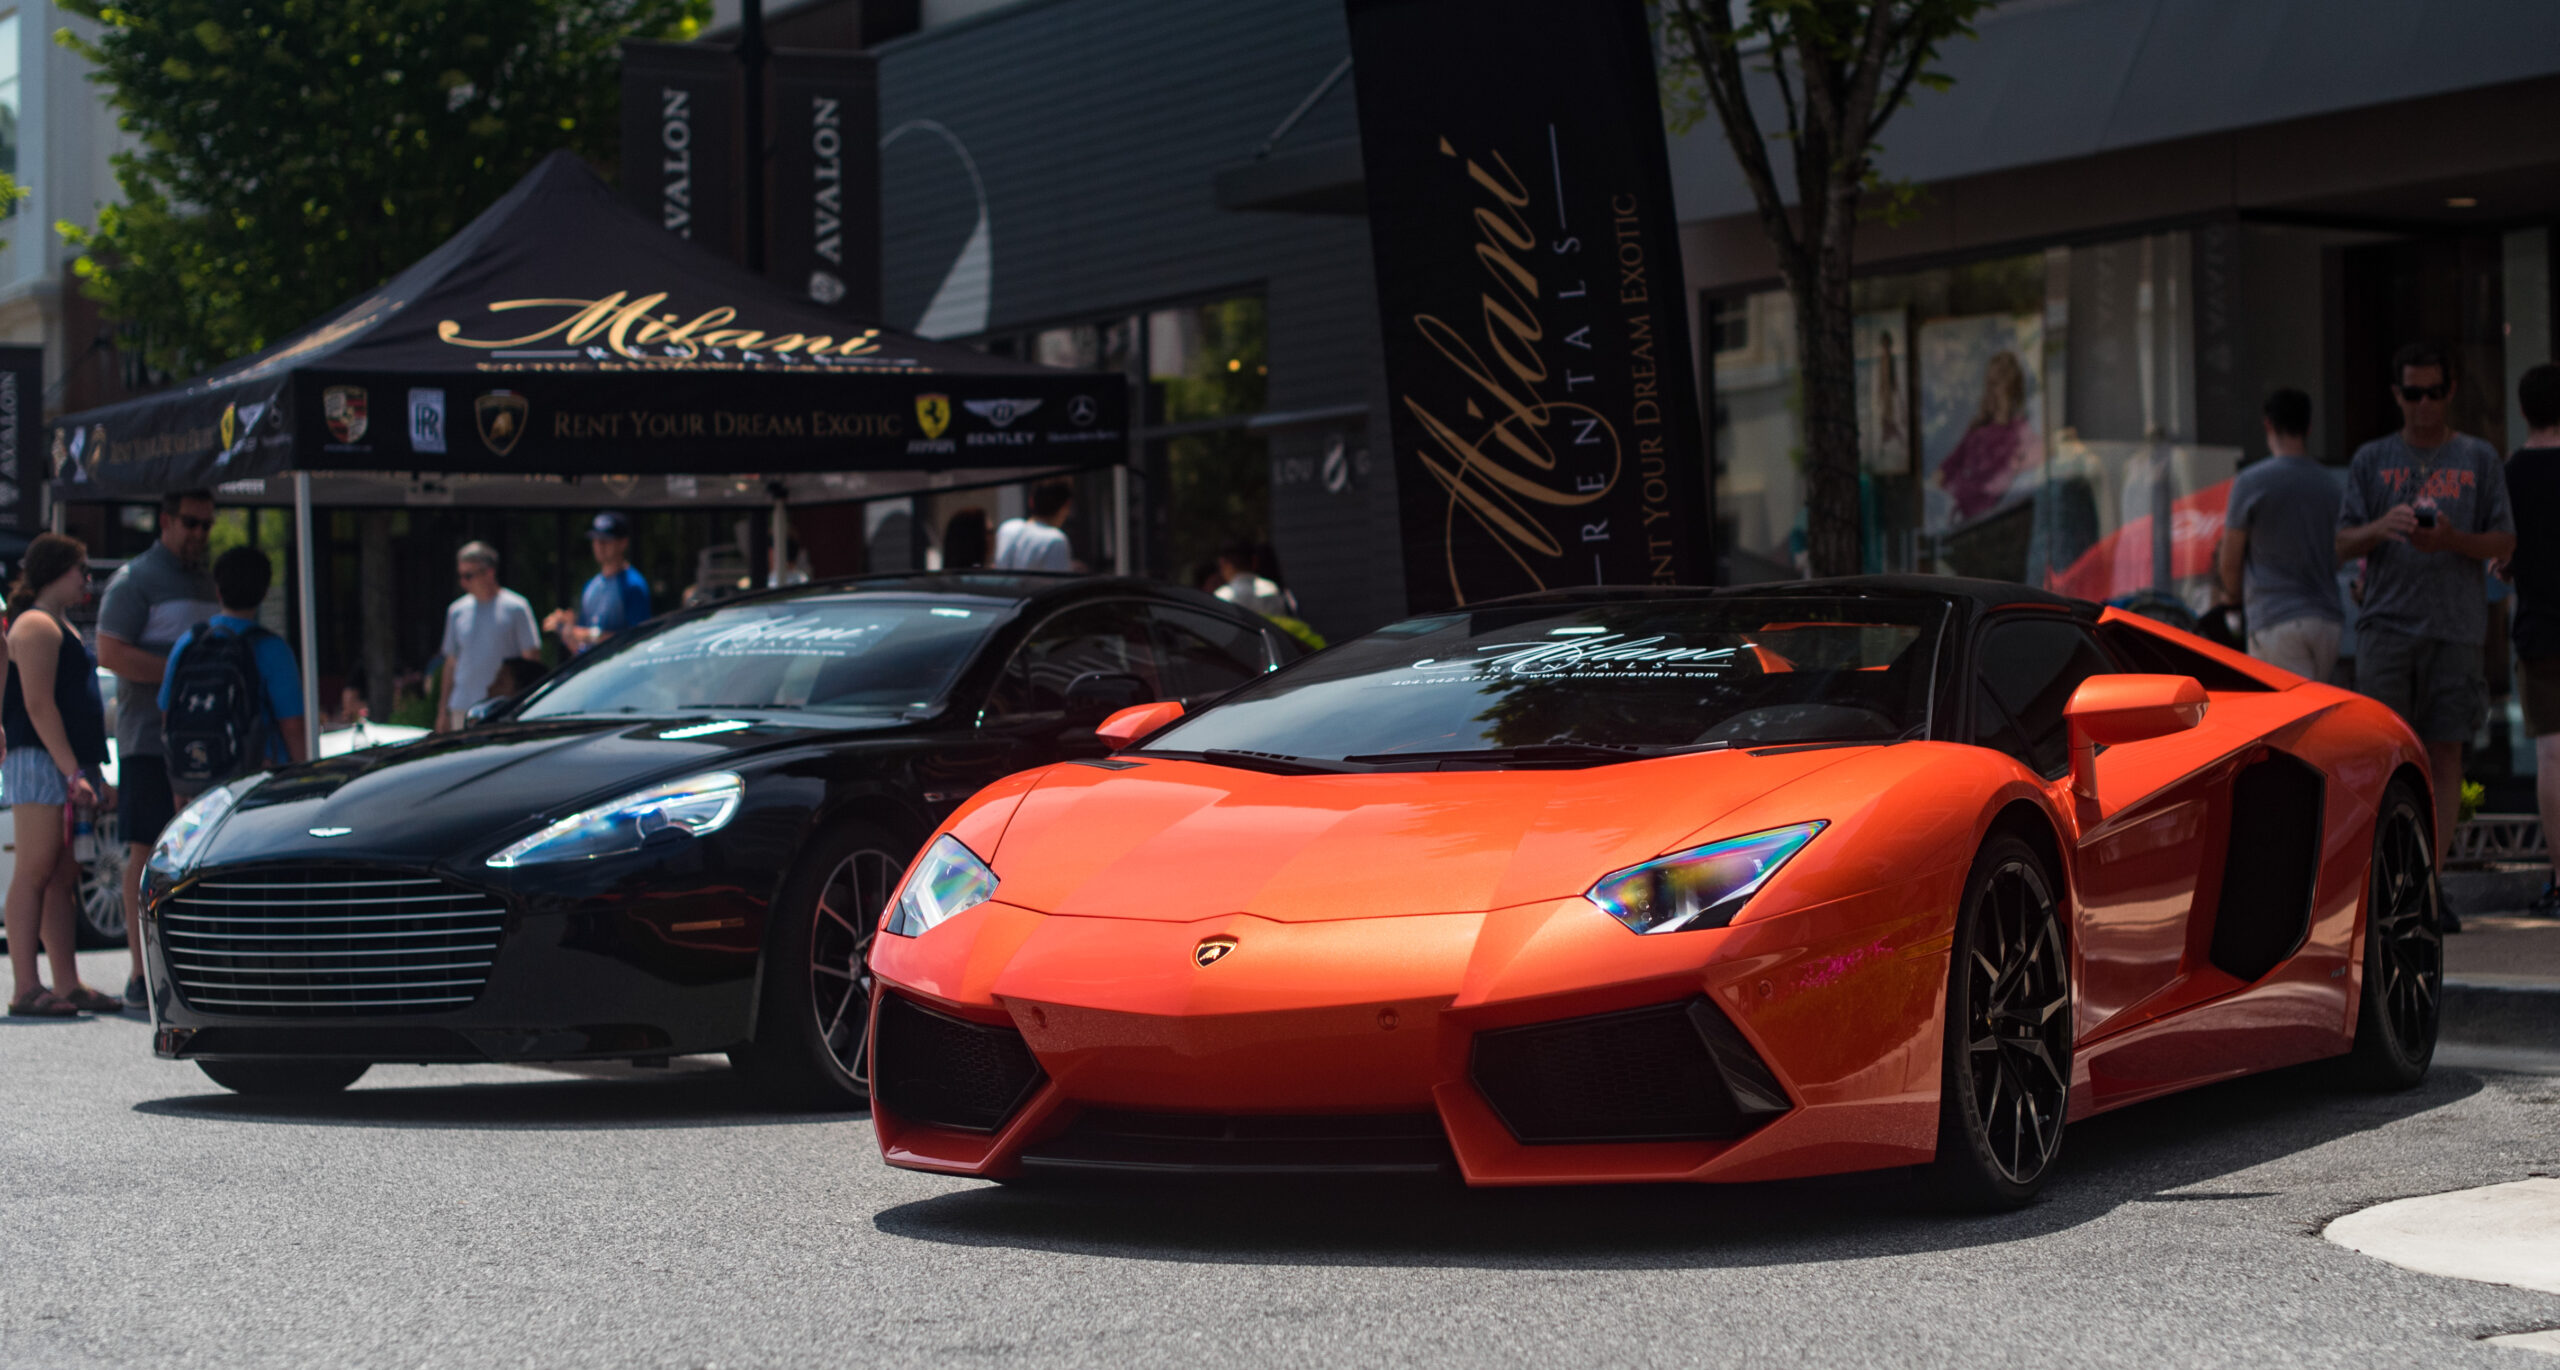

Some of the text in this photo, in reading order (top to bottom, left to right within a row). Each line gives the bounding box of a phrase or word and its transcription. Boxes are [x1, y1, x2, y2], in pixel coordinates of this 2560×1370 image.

[812, 95, 843, 266] AVALON
[1612, 192, 1649, 306] EXOTIC
[438, 290, 881, 361] Milani
[1403, 133, 1621, 607] Milani
[1552, 236, 1612, 544] RENTALS
[1632, 314, 1664, 428] DREAM
[554, 410, 902, 438] RENT YOUR DREAM EXOTIC
[966, 432, 1036, 446] BENTLEY
[1639, 435, 1672, 528] YOUR
[1413, 633, 1758, 674] Milani
[1487, 660, 1668, 674] RENTALS
[1528, 671, 1720, 680] www.milanirentals.com
